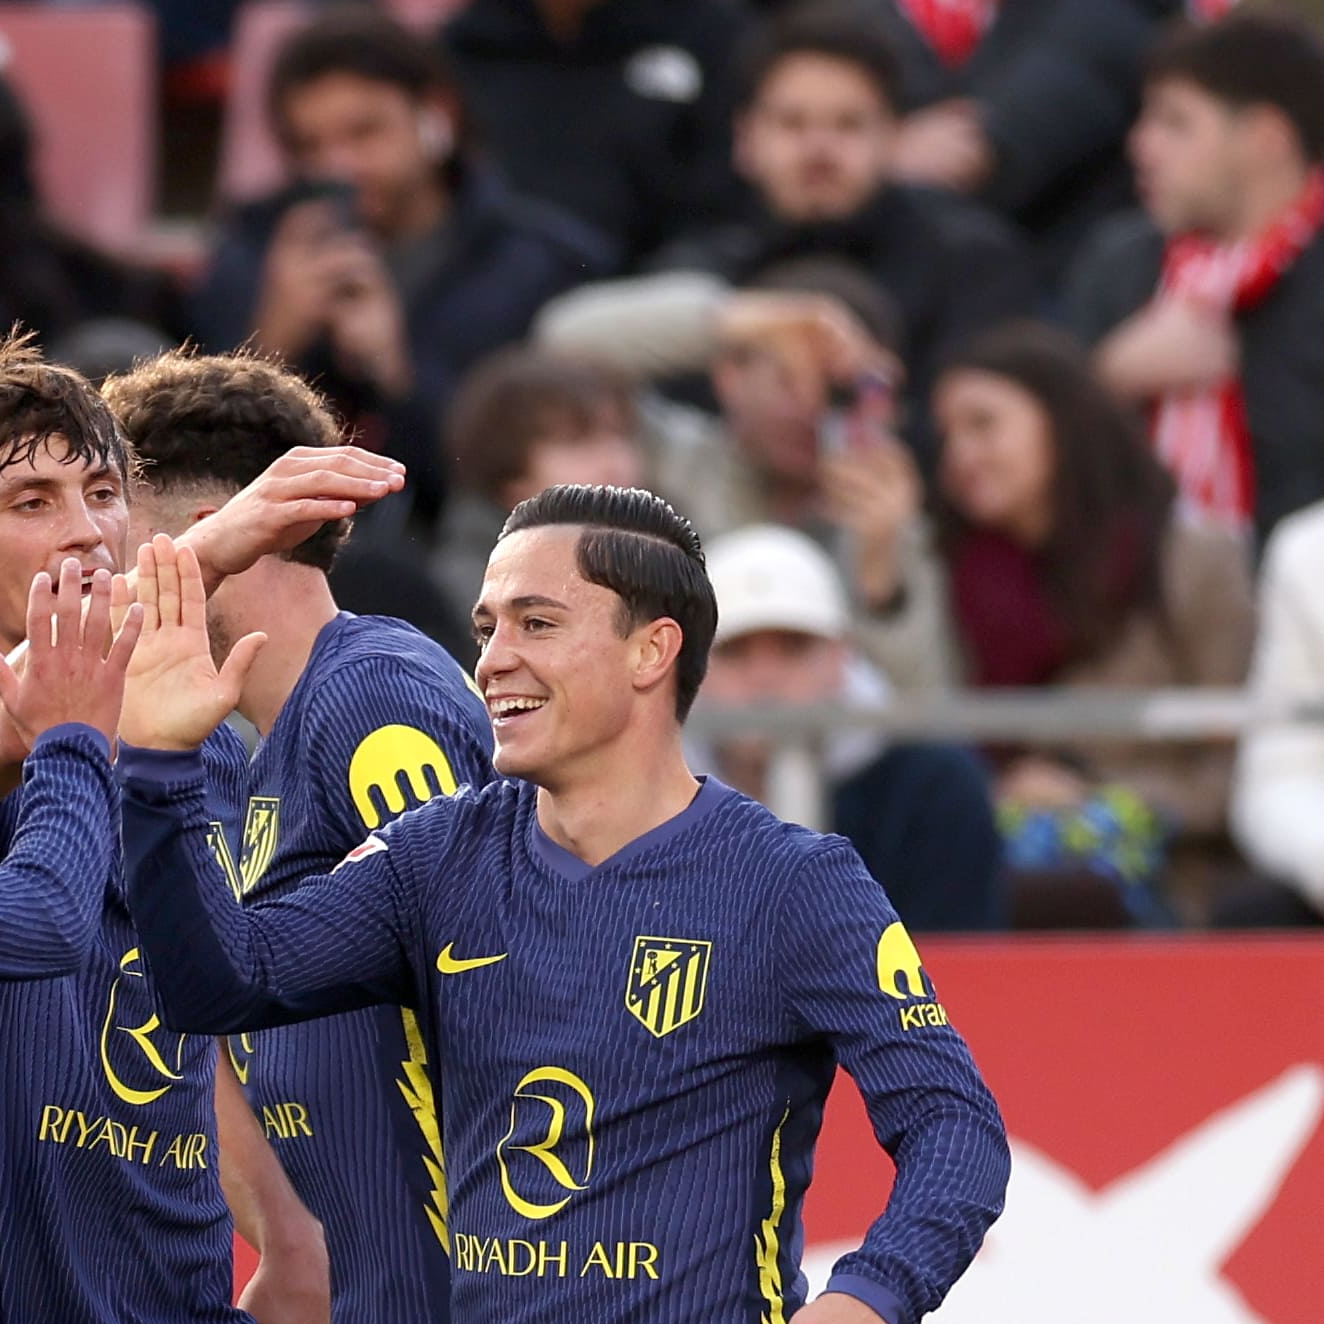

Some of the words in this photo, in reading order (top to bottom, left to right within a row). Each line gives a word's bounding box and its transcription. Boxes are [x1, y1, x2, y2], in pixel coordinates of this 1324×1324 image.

[38, 1104, 158, 1164] RIYADH
[159, 1133, 208, 1169] AIR
[263, 1102, 313, 1139] AIR
[455, 1232, 568, 1278] RIYADH
[579, 1241, 660, 1280] AIR
